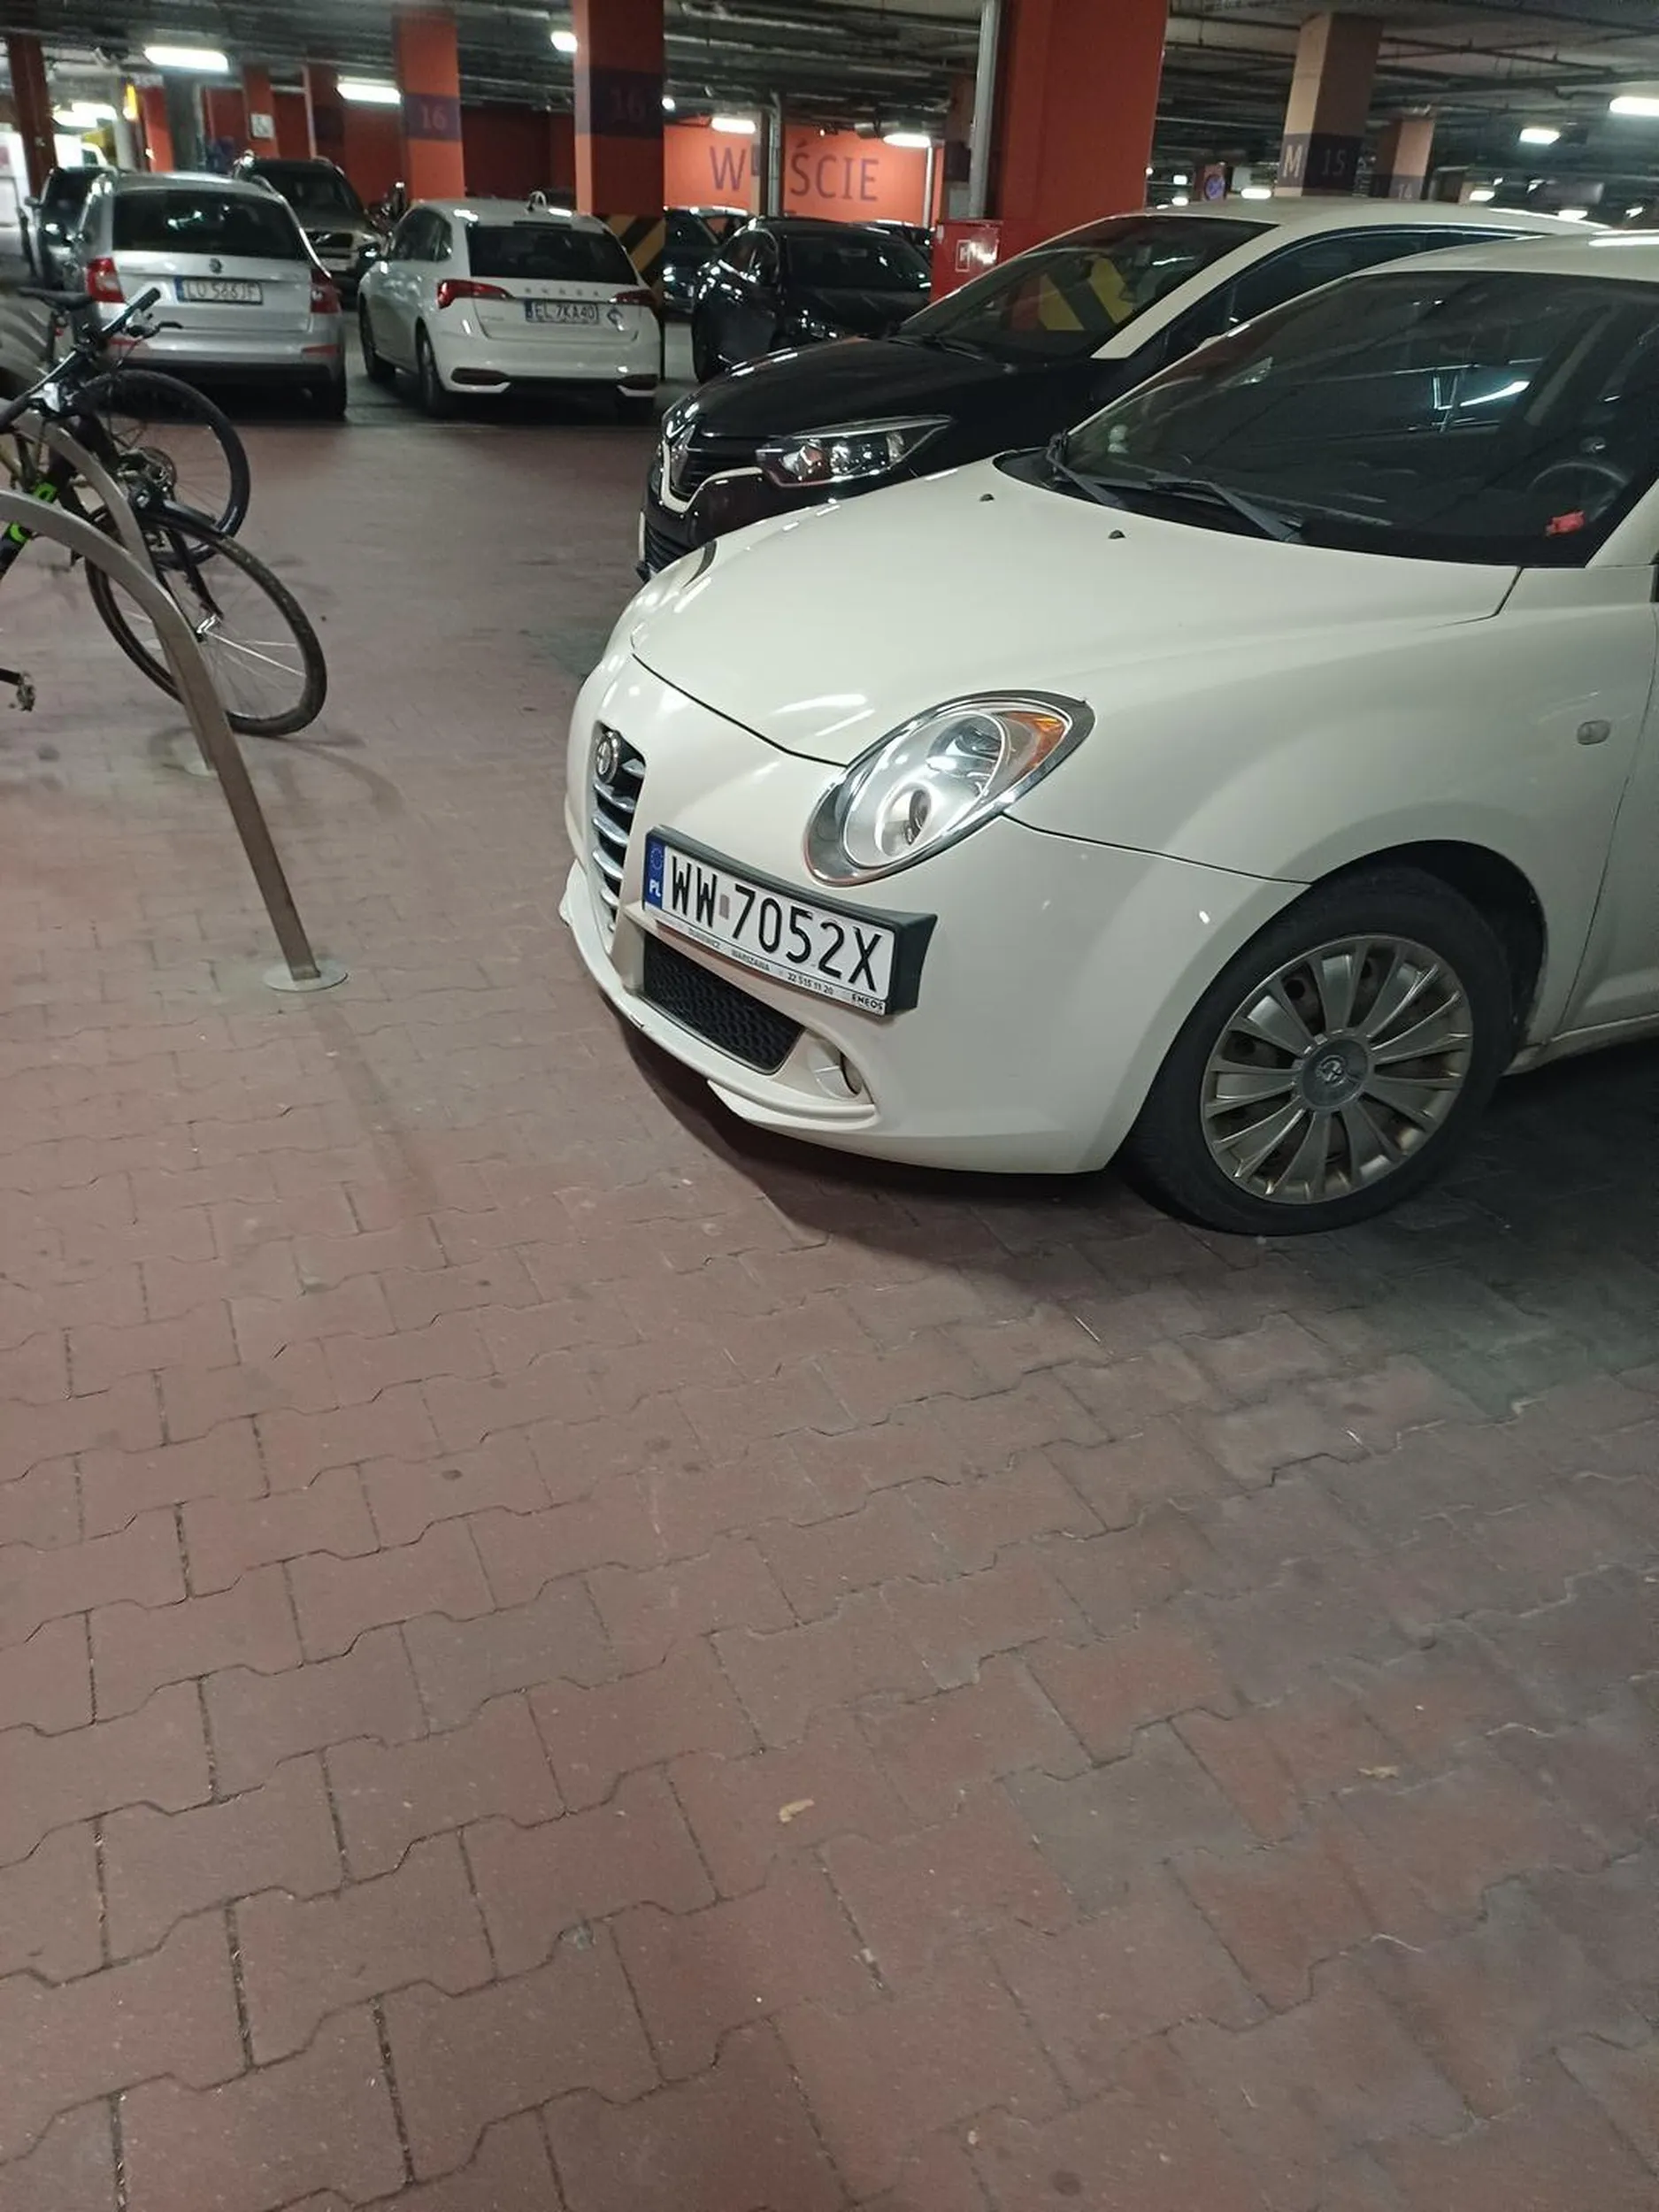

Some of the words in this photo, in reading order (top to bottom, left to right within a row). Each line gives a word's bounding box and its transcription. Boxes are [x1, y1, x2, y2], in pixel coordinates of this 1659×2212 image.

[421, 104, 448, 131] 16
[710, 139, 879, 201] WŚCIE
[1283, 144, 1302, 178] M
[1321, 148, 1346, 176] 15
[649, 879, 661, 897] PL
[672, 856, 718, 928] WW
[732, 884, 883, 992] 7052X
[851, 993, 883, 1010] ENEOS
